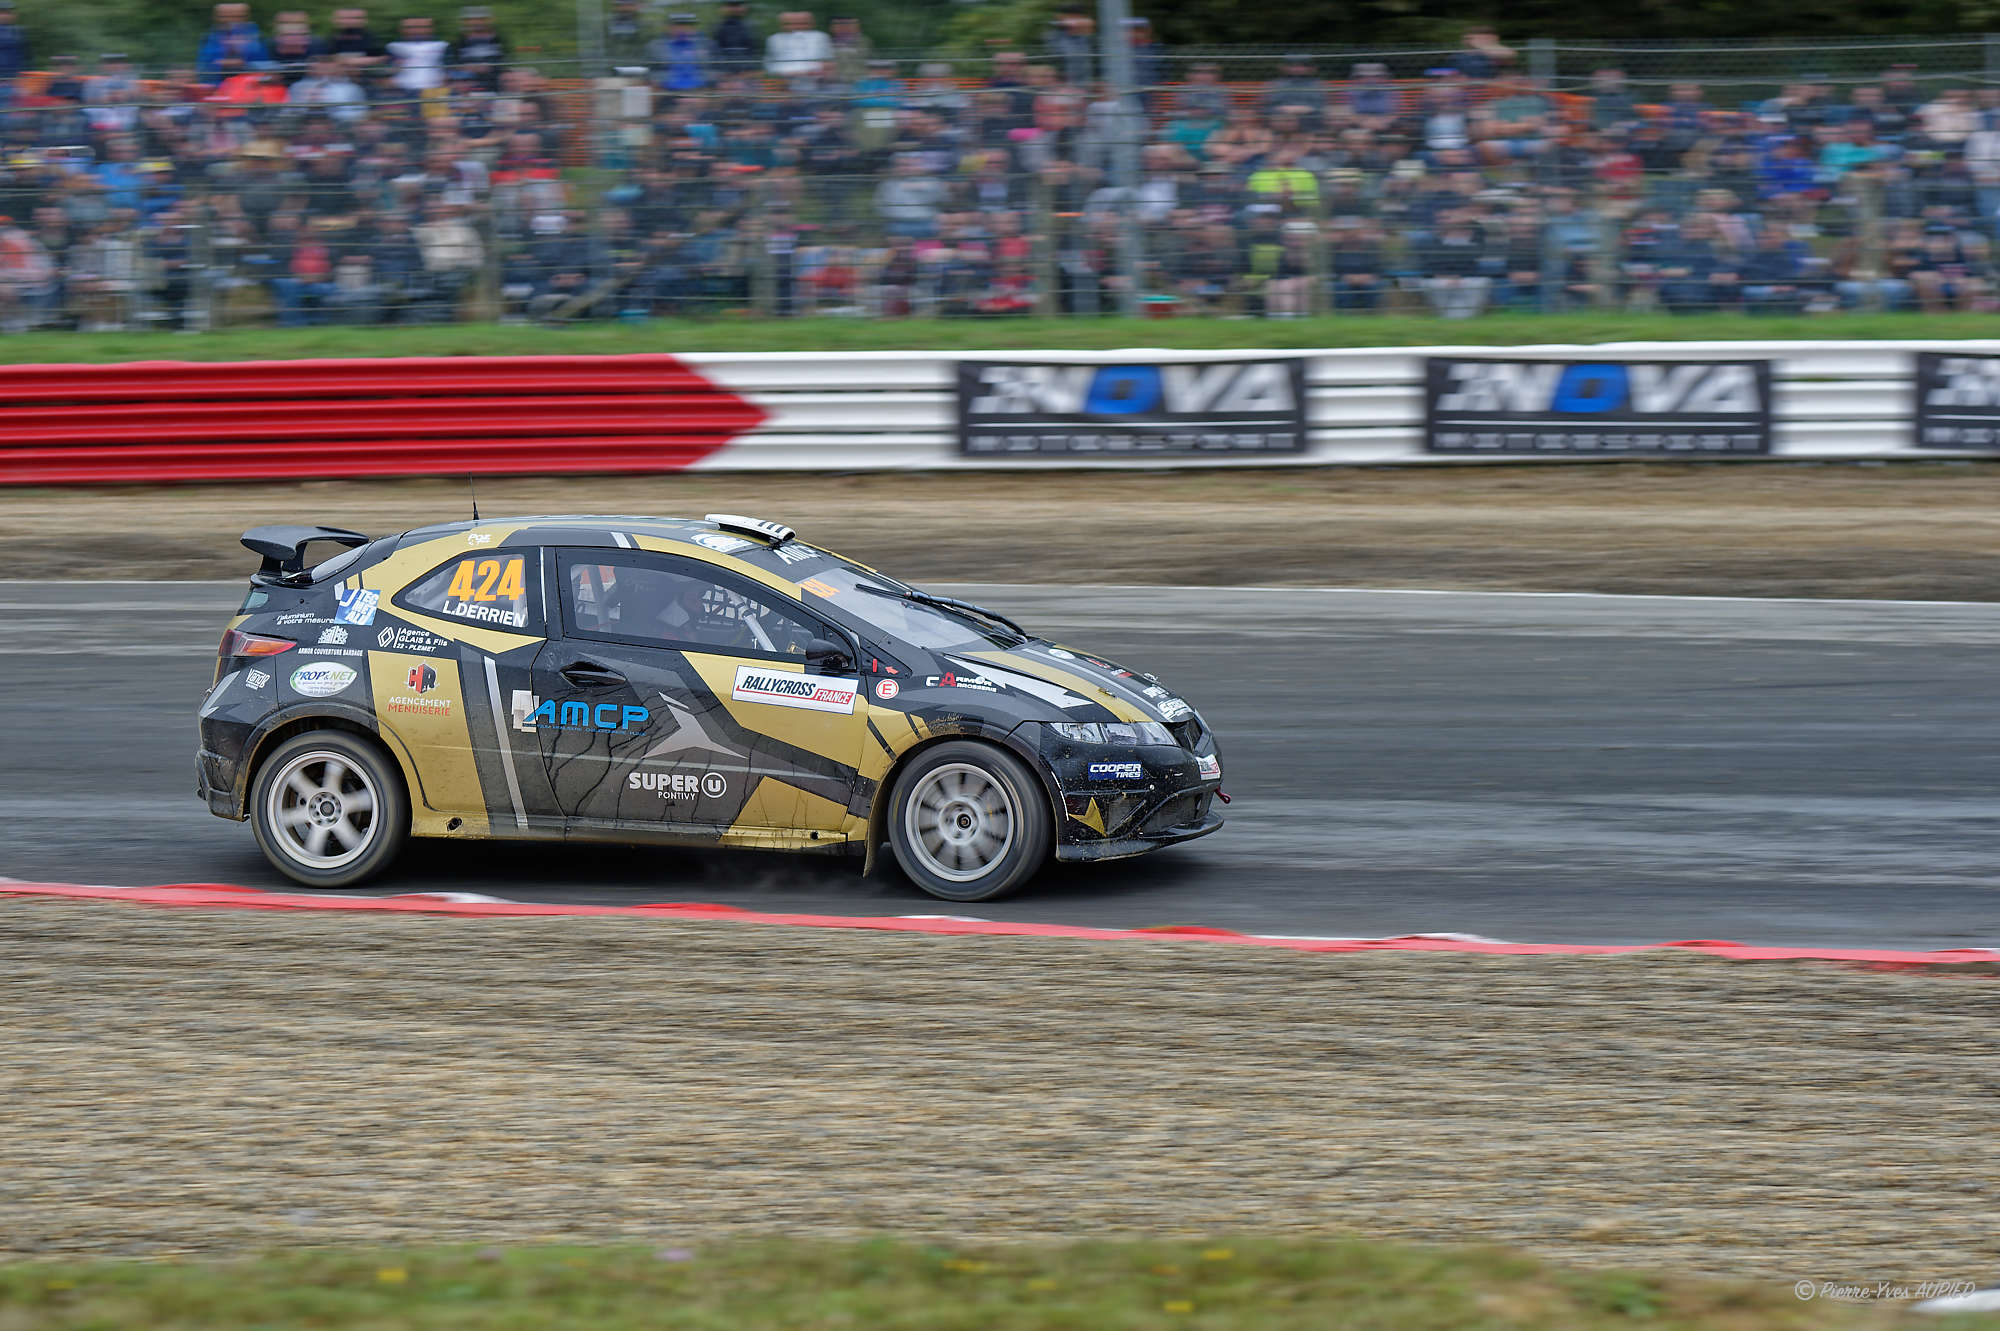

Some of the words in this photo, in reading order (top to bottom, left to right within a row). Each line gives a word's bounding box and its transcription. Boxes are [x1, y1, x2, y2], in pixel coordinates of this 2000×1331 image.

[447, 558, 526, 602] 424
[442, 600, 525, 627] L.DERRIEN
[400, 627, 430, 637] Agence
[742, 675, 816, 696] RALLYCROSS
[814, 690, 852, 704] FRANCE
[388, 696, 451, 707] AGENCEMENT
[387, 703, 451, 716] MENUISERIE
[522, 699, 649, 730] AMCP
[1089, 763, 1142, 773] COOPER
[1115, 771, 1141, 779] TIRES
[628, 772, 699, 793] SUPER
[658, 791, 696, 801] PONTIVY
